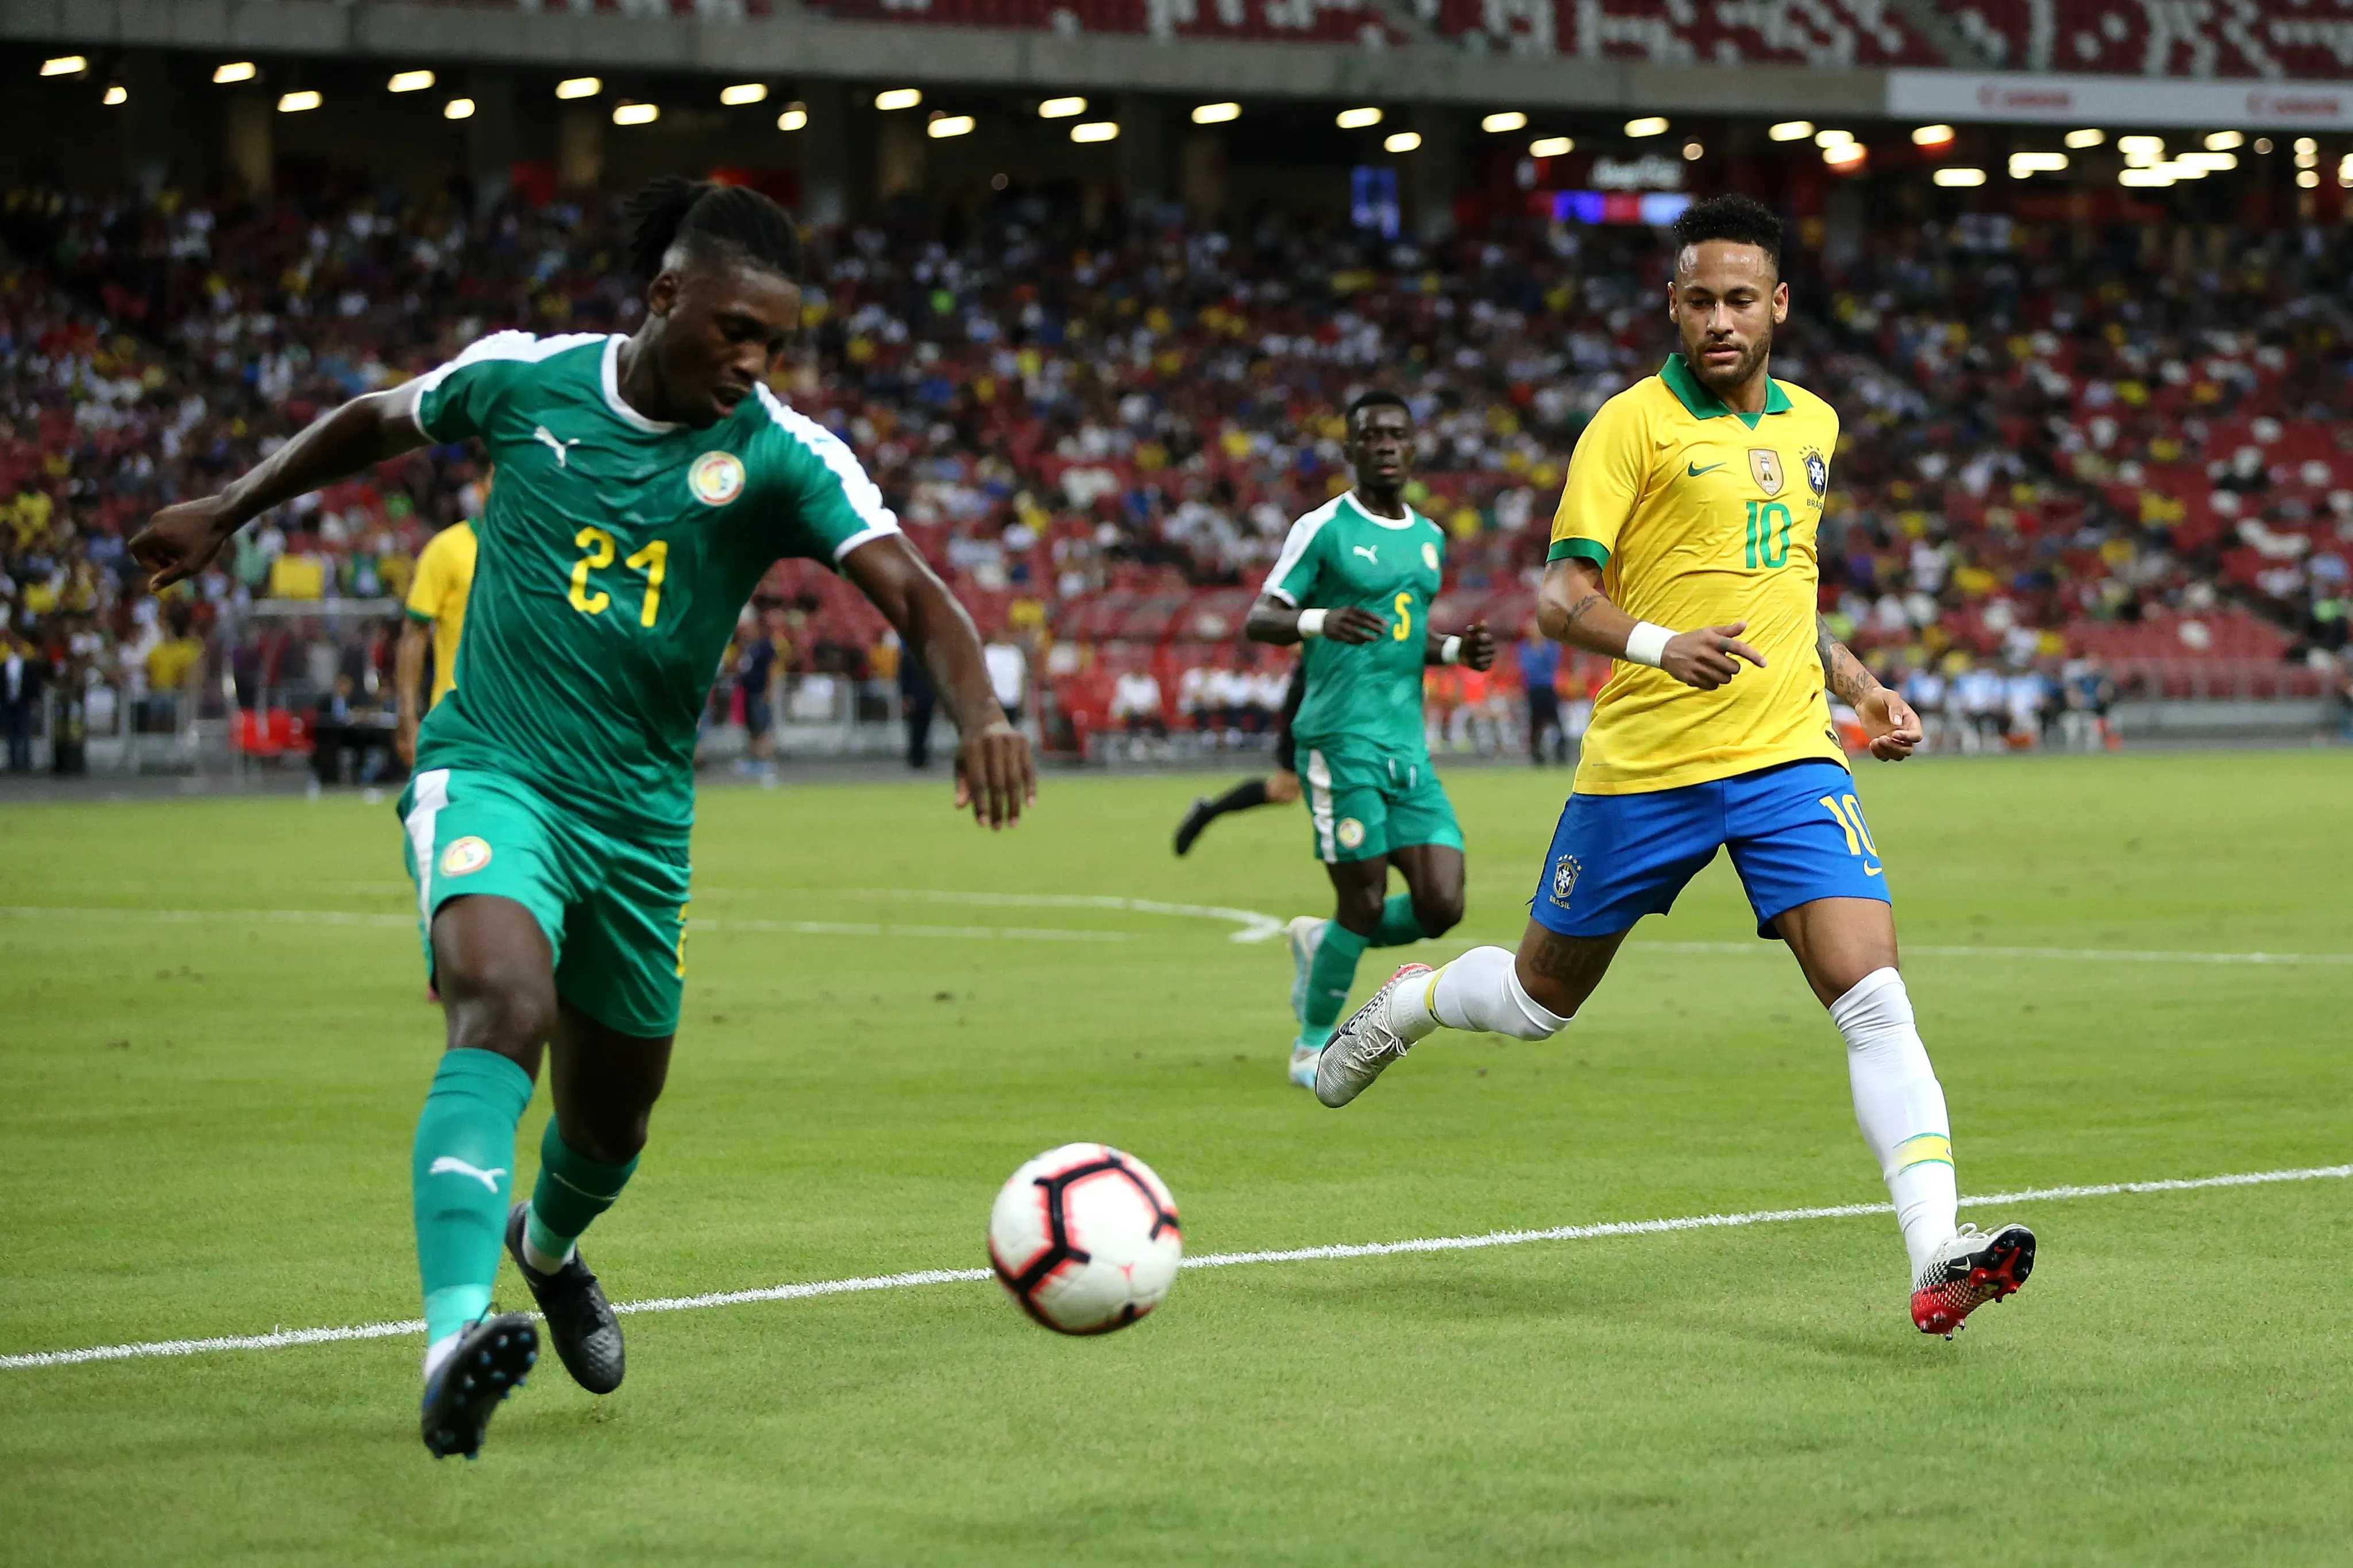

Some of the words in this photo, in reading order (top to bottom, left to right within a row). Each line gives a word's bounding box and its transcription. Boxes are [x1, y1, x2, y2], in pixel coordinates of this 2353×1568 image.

[1746, 501, 1792, 569] 10
[568, 526, 668, 628] 21
[1392, 592, 1413, 642] 5
[1819, 794, 1878, 858] 10
[1549, 895, 1571, 909] BRASIL
